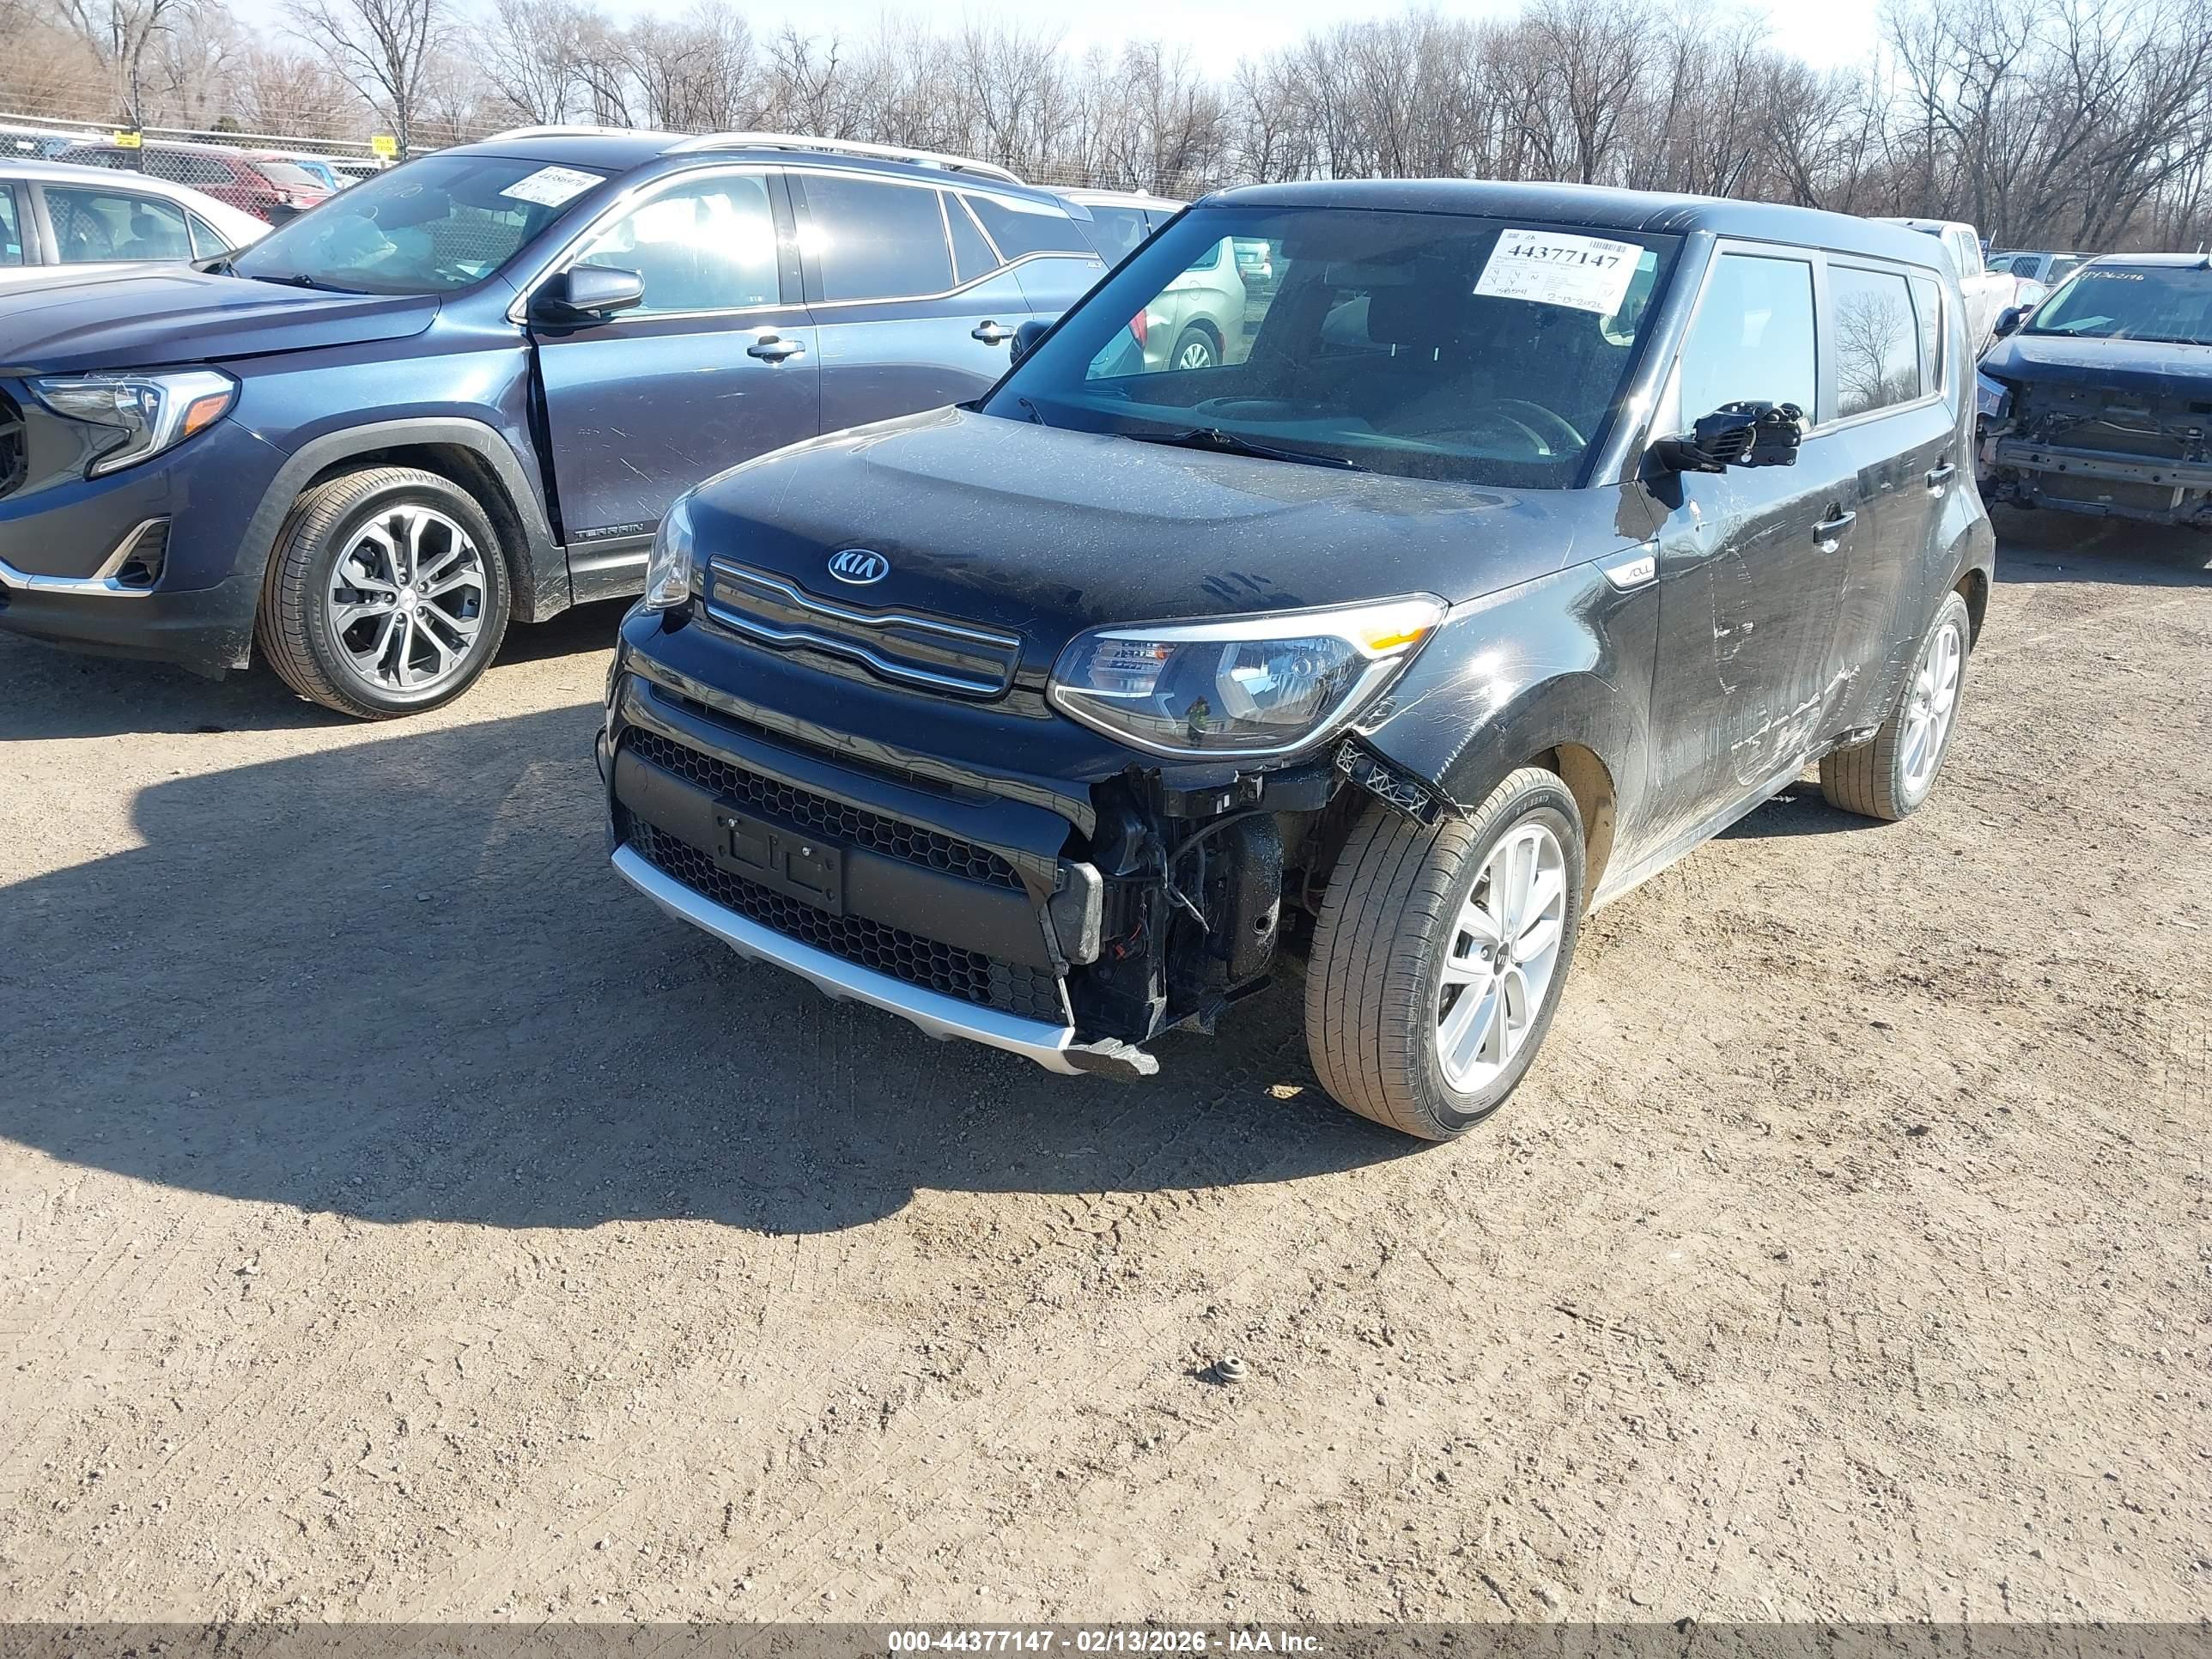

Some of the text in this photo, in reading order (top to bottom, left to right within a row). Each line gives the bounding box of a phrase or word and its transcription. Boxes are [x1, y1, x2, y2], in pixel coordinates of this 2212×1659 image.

[1507, 244, 1621, 270] 44377147
[574, 523, 644, 538] TERRAIN
[834, 552, 877, 578] KIA
